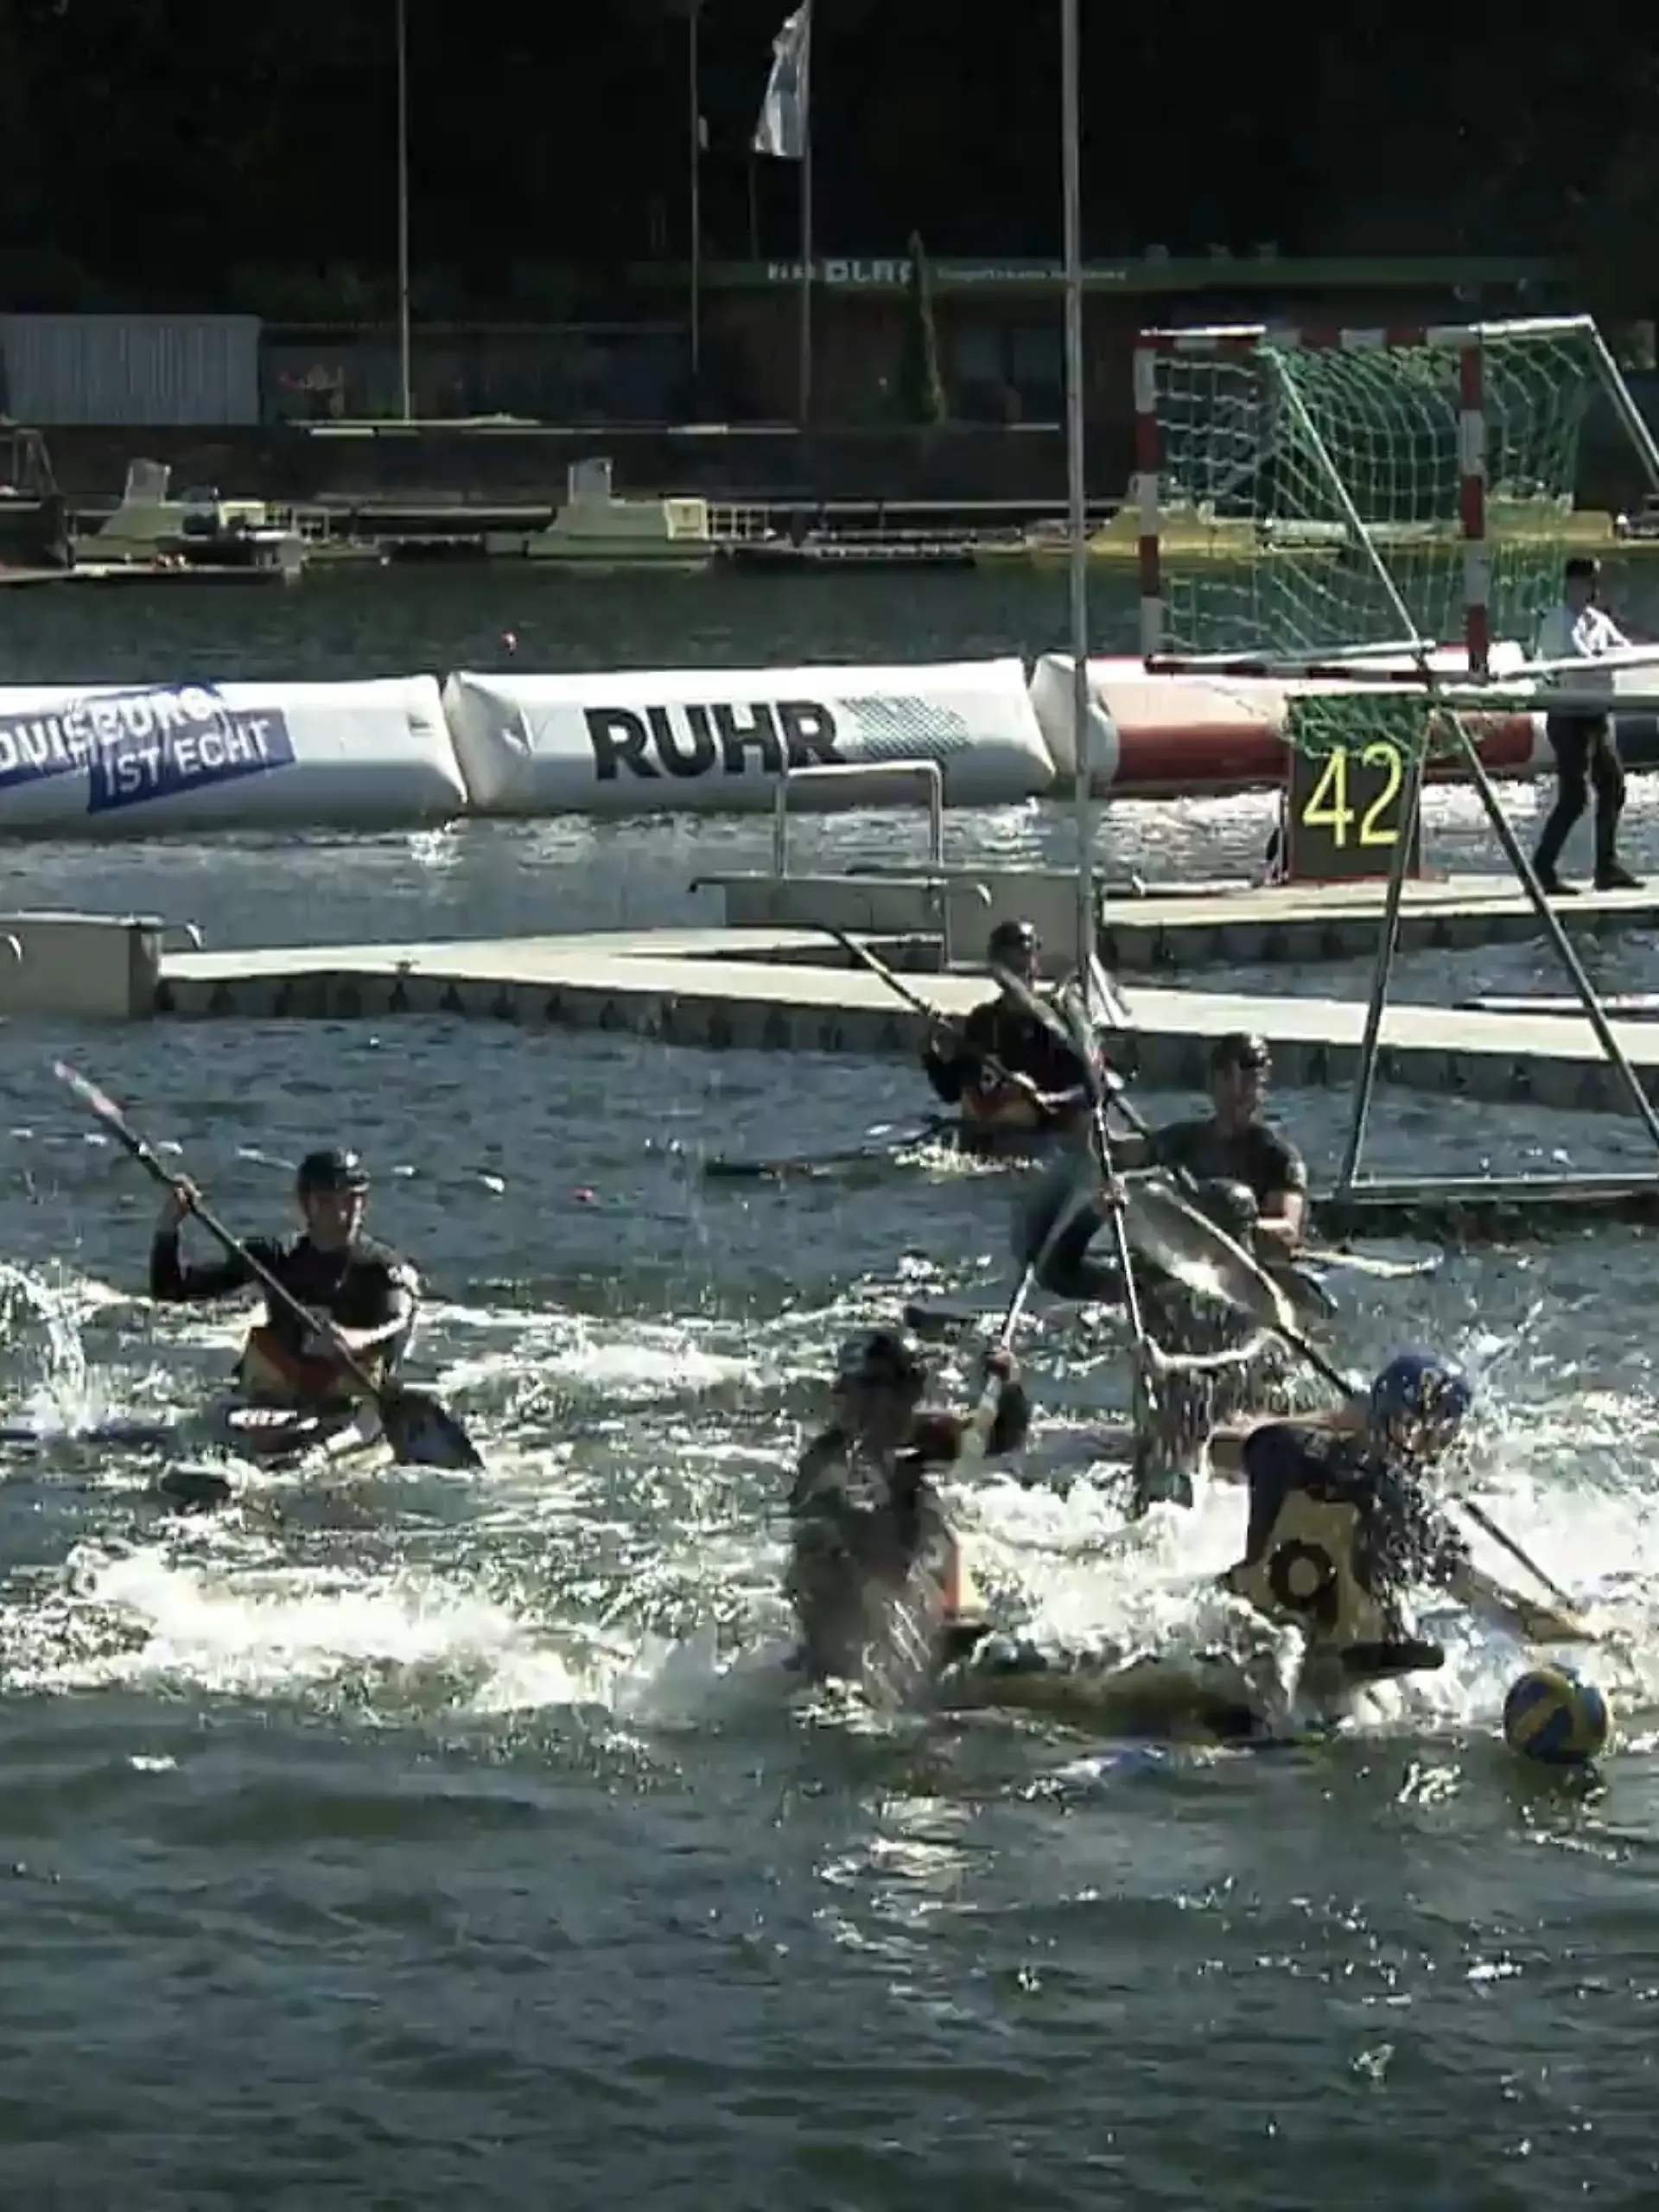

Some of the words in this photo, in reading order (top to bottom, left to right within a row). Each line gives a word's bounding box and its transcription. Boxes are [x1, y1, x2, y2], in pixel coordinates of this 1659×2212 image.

[105, 746, 161, 796] IST
[174, 720, 270, 776] ECHT
[583, 700, 846, 780] RUHR
[1302, 741, 1402, 847] 42
